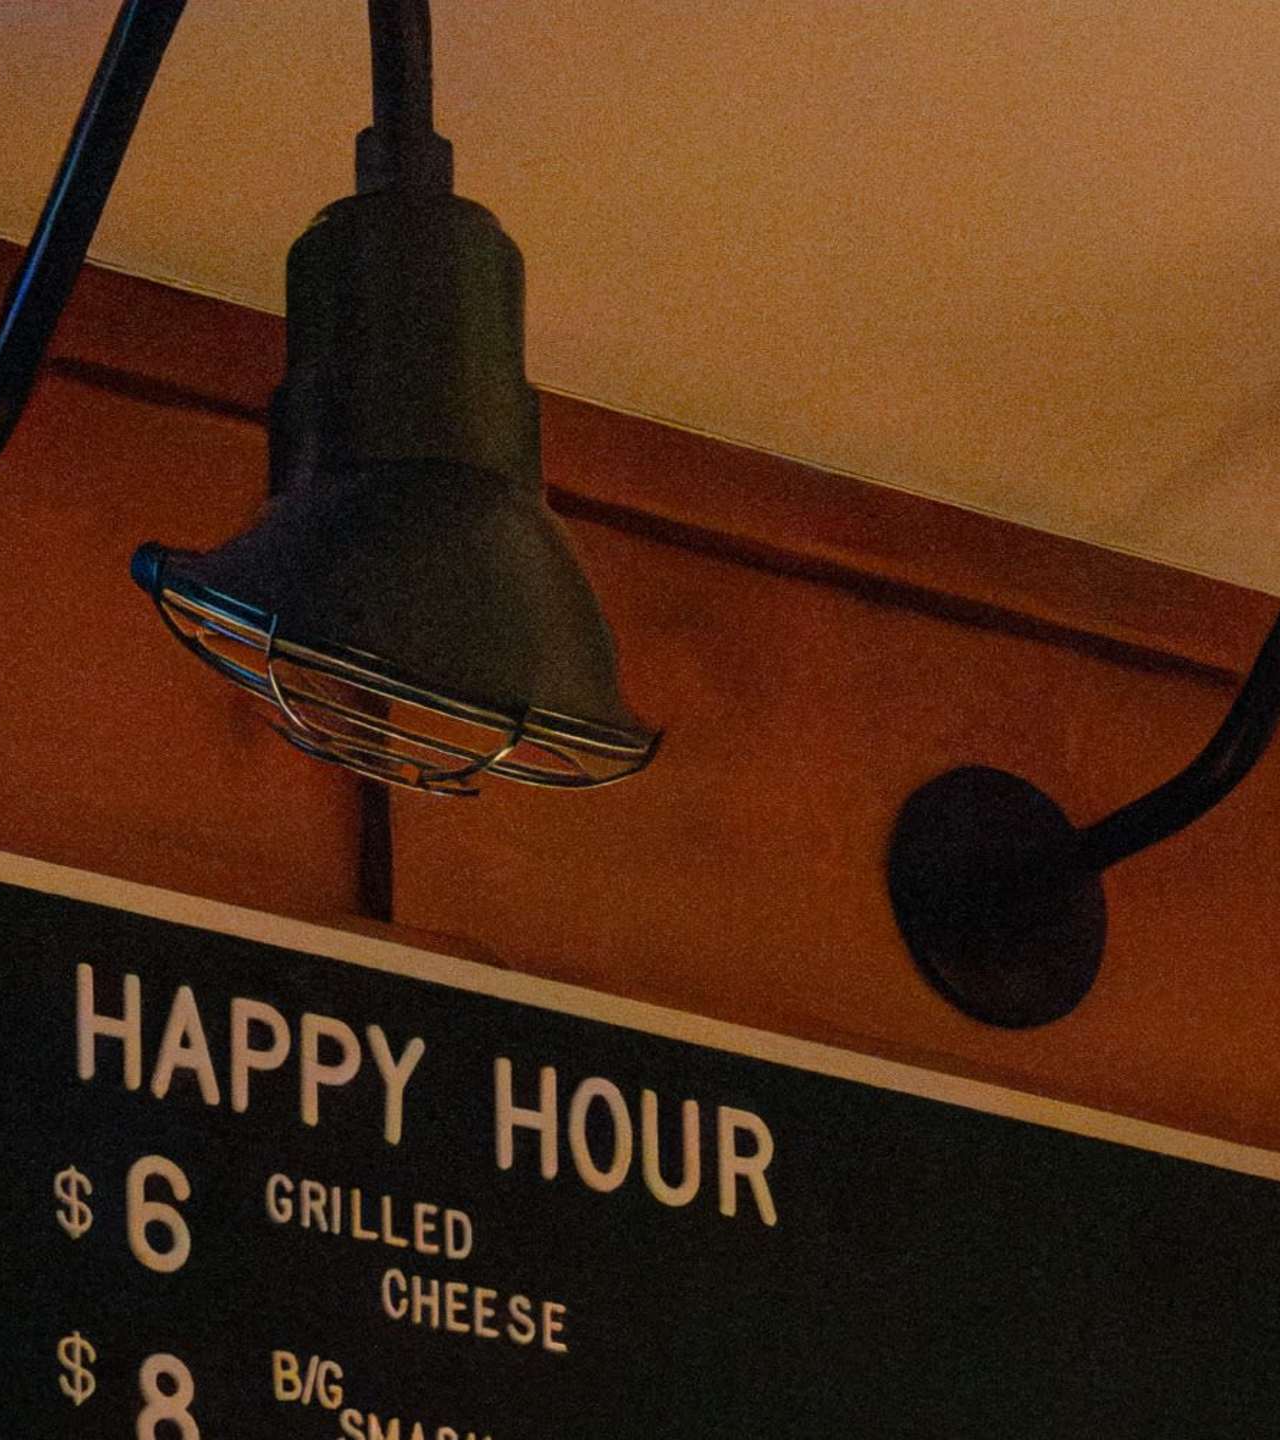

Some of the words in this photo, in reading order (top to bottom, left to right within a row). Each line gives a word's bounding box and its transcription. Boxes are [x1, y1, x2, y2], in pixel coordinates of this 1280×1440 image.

[76, 962, 426, 1145] HAPPY
[494, 1057, 778, 1227] HOUR
[266, 1173, 473, 1260] GRILLED
[381, 1268, 568, 1353] CHEESE
